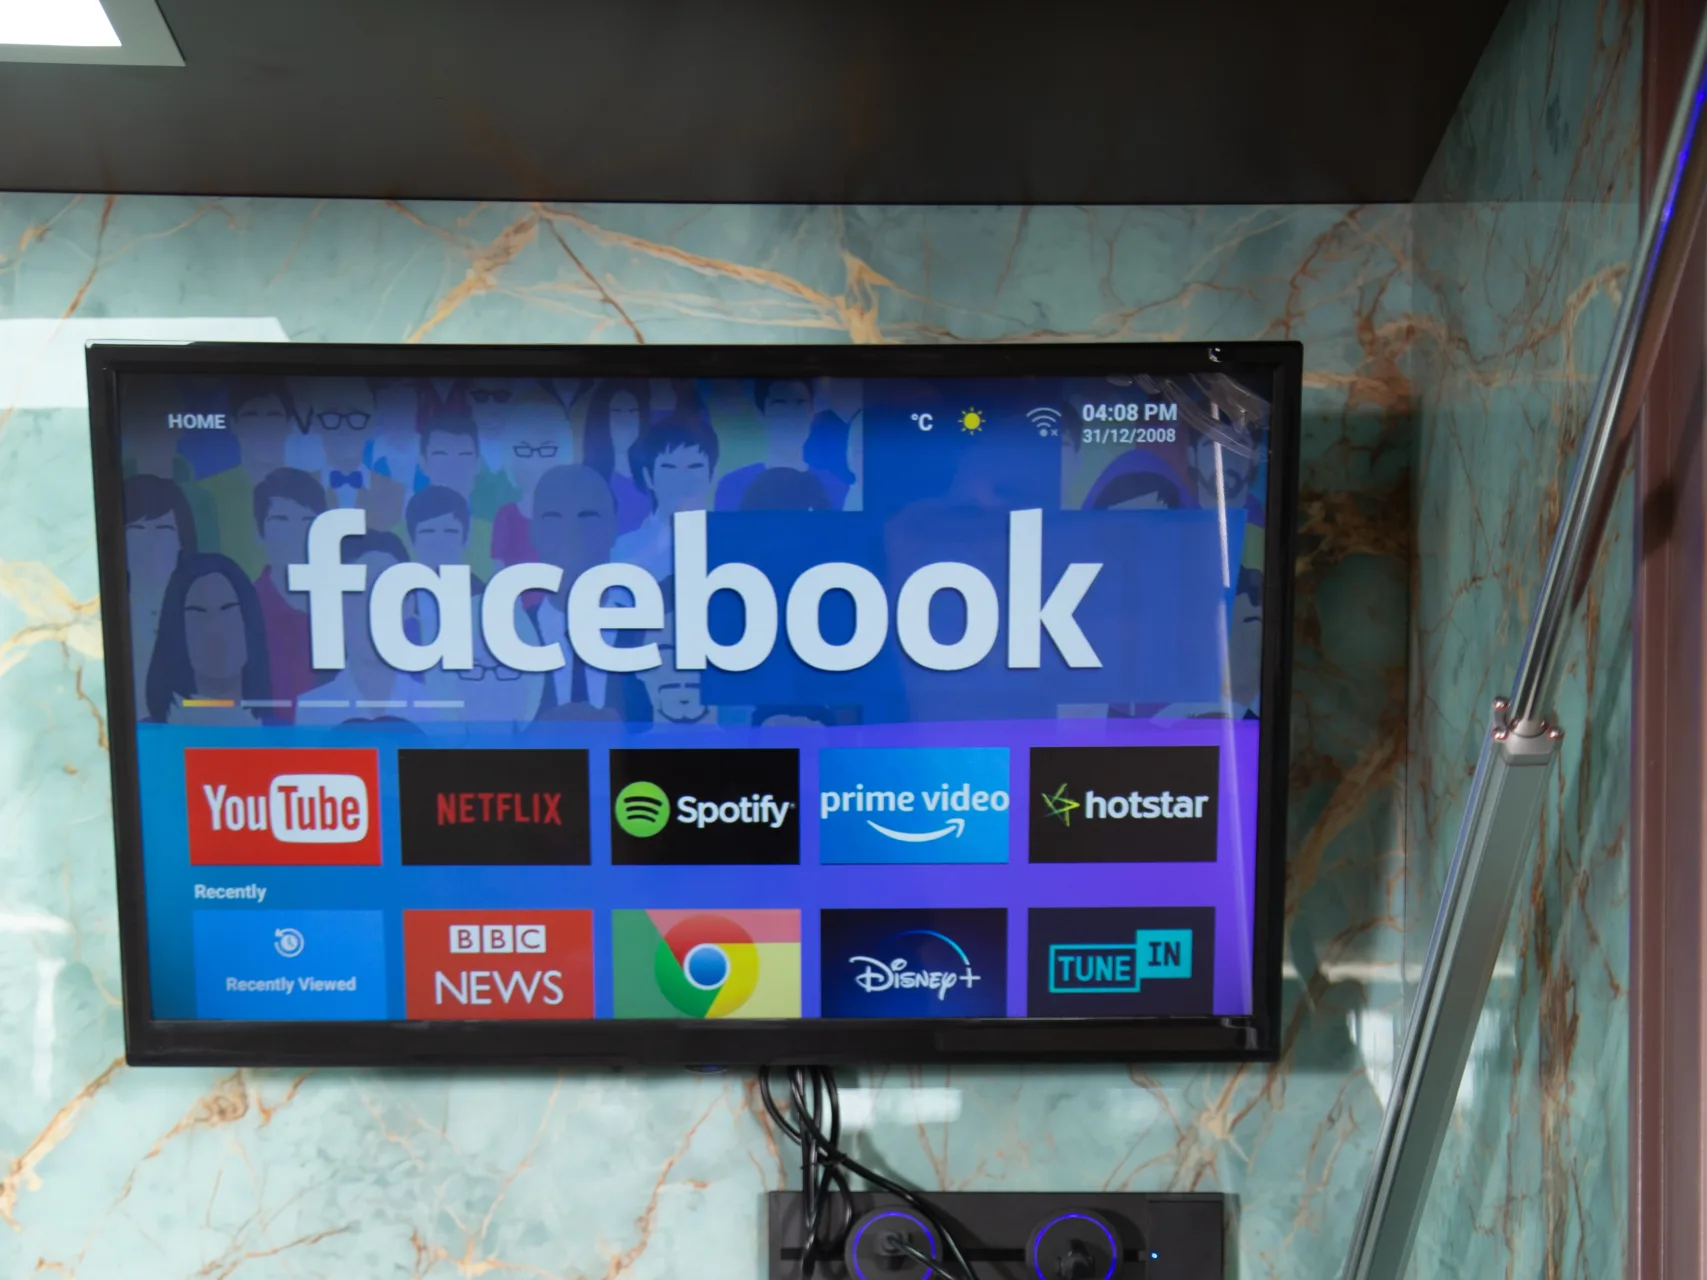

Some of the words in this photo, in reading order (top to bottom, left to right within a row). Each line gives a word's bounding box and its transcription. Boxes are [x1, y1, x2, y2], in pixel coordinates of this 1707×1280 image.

[167, 414, 226, 429] HOME
[1082, 403, 1139, 422] 04:08
[1144, 403, 1178, 421] PM
[1082, 427, 1177, 445] 31/12/2008
[288, 507, 1104, 672] facebook
[203, 784, 361, 832] YouTube
[436, 792, 563, 826] NETFLIX
[676, 793, 790, 828] Spotify
[820, 784, 914, 819] prime
[921, 783, 1010, 812] video
[1085, 790, 1209, 819] hotstar
[194, 884, 267, 903] Recently
[1058, 953, 1132, 983] TUNE
[1148, 941, 1181, 967] IN
[225, 976, 295, 996] Recently
[299, 976, 357, 993] Viewed
[434, 970, 564, 1006] NEWS
